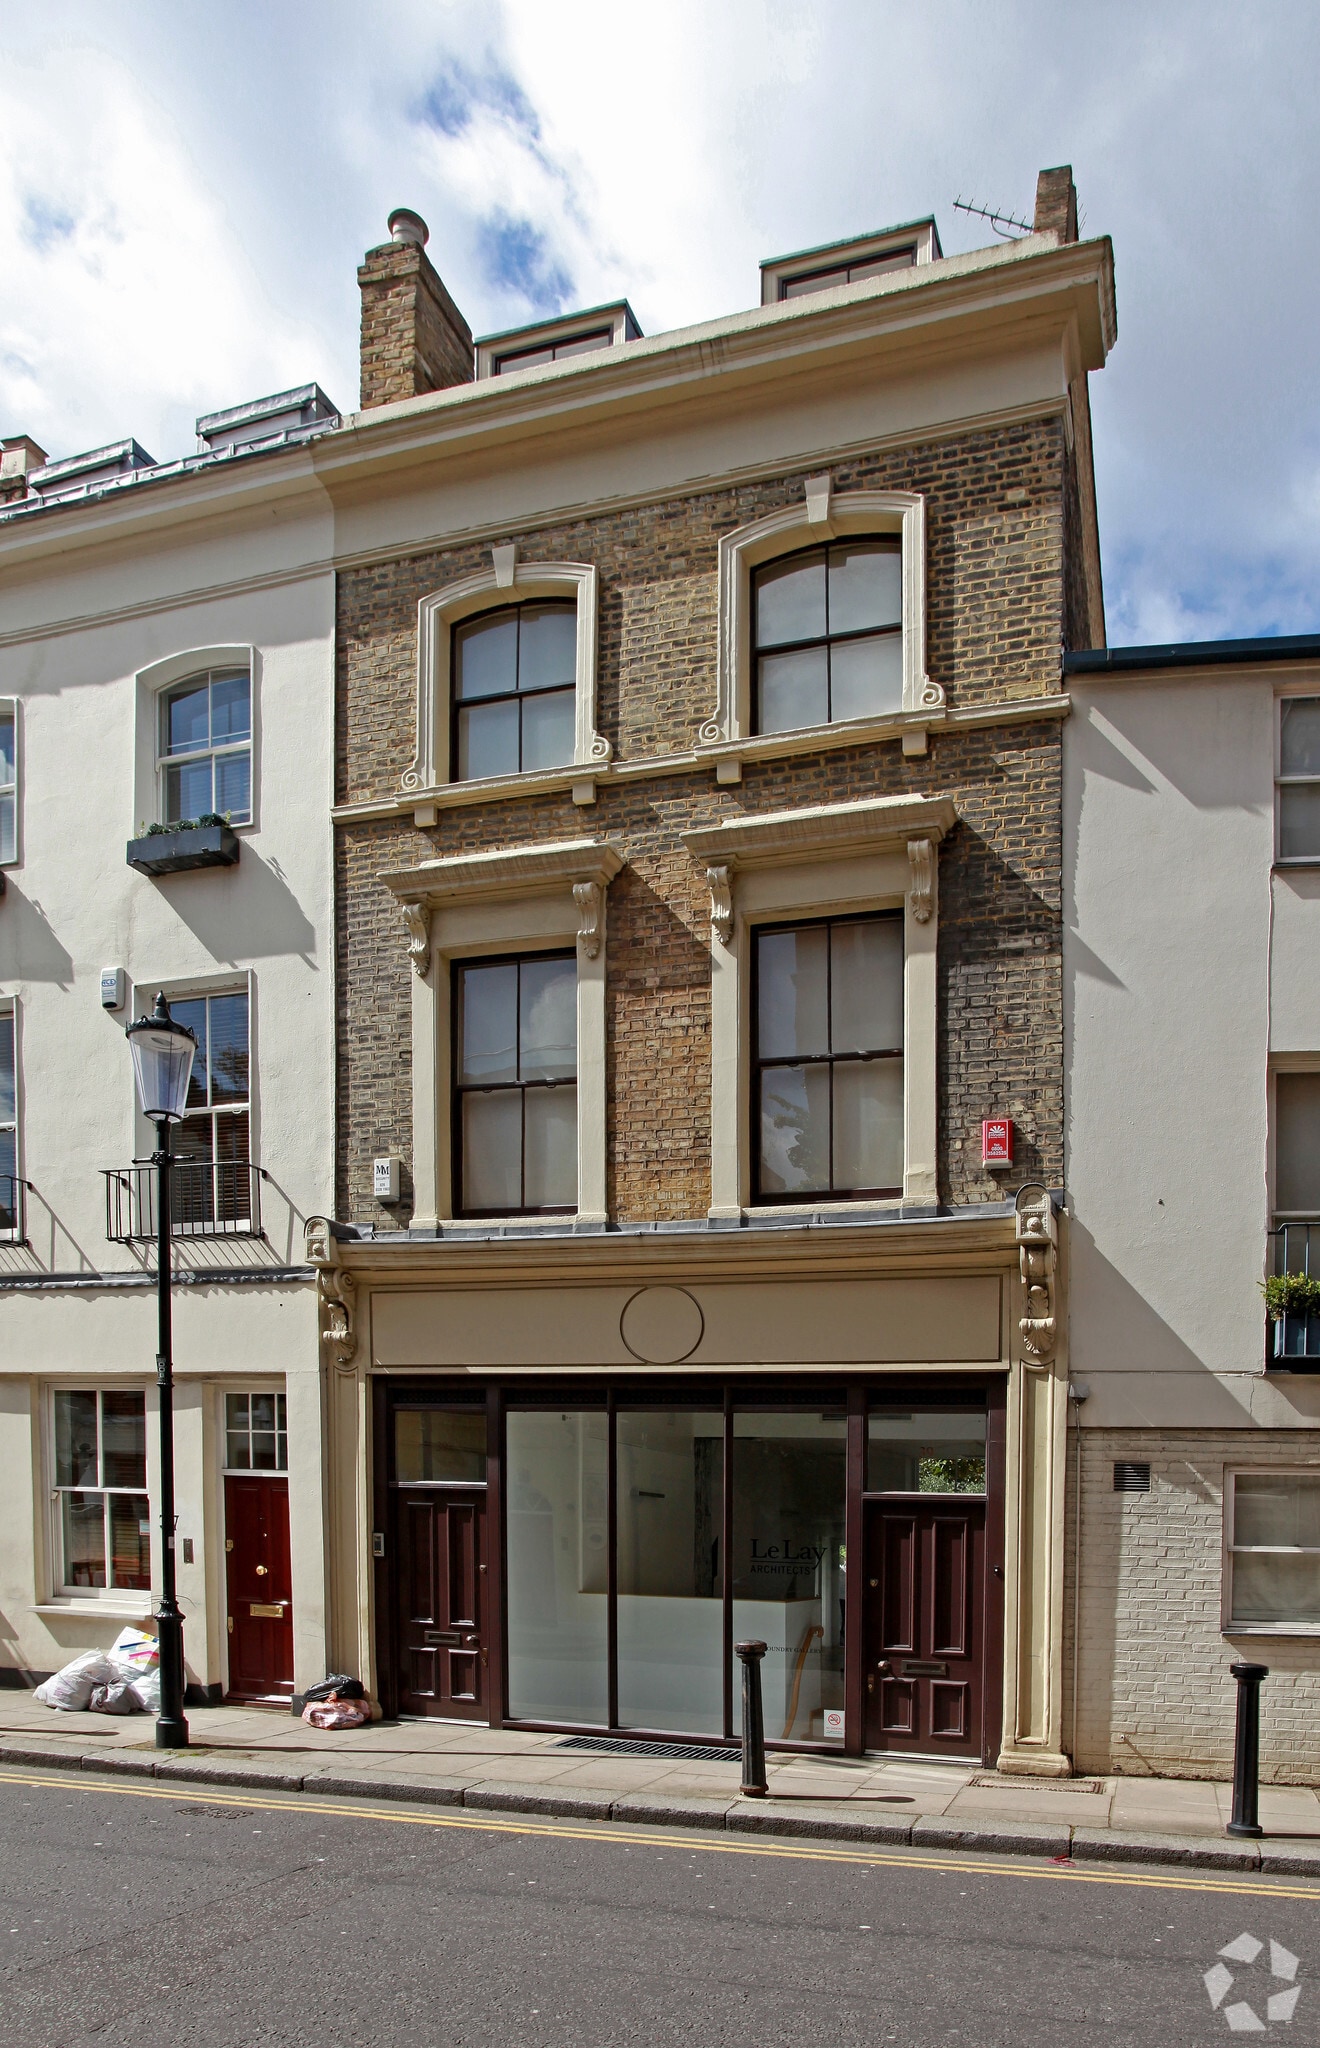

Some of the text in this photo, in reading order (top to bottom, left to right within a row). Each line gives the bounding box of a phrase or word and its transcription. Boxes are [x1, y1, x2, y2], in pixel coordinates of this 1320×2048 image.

[750, 1538, 828, 1571] Le Lay
[750, 1564, 811, 1576] ARCHITECTS
[766, 1645, 793, 1653] OUNDRY
